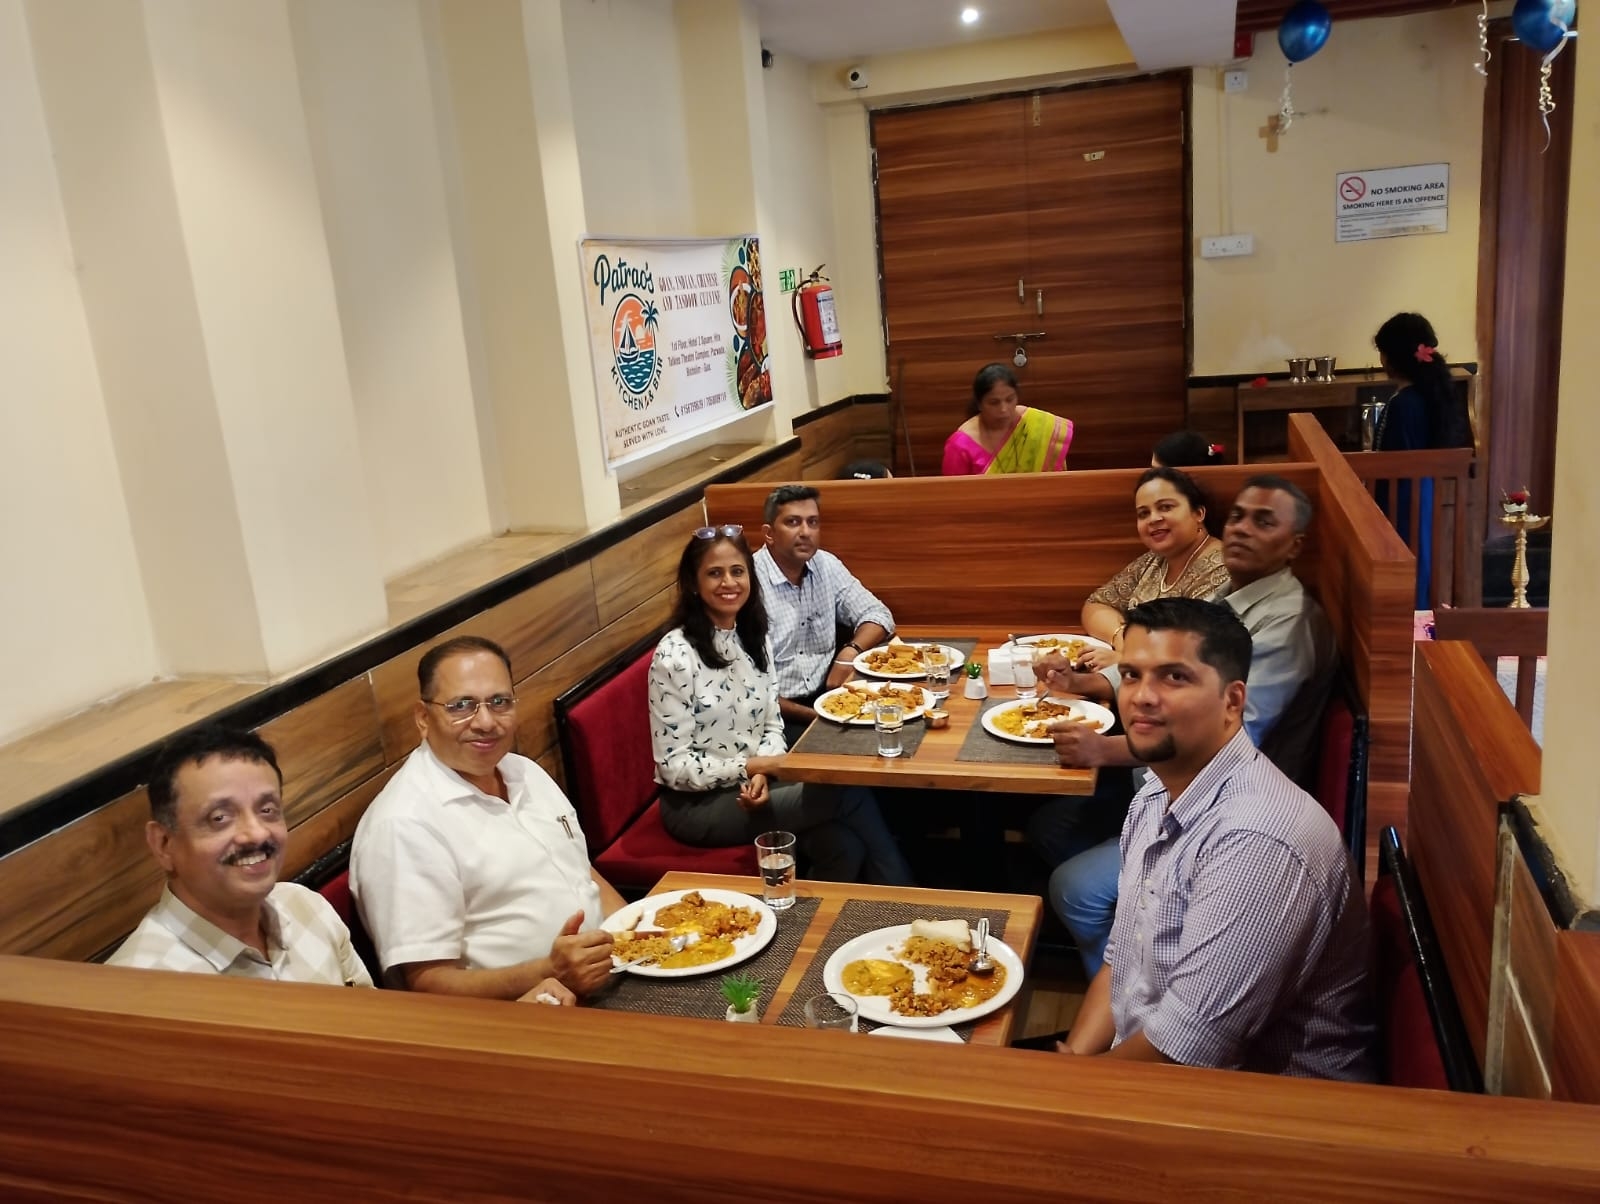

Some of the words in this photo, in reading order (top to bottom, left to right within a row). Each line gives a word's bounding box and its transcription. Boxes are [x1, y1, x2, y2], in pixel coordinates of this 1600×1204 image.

[1384, 184, 1422, 195] SMOKING
[1424, 182, 1445, 190] AREA
[1342, 202, 1375, 210] SMOKING
[1376, 199, 1393, 207] HERE
[1414, 194, 1445, 203] OFFENCE
[594, 254, 654, 306] Patrao's
[611, 365, 644, 410] KITCHEN
[653, 356, 663, 391] BAR
[615, 422, 642, 438] AUTHENTIC
[642, 418, 656, 429] GOAN
[656, 413, 670, 424] TASTE
[623, 435, 641, 449] SERVED
[641, 430, 654, 441] WITH
